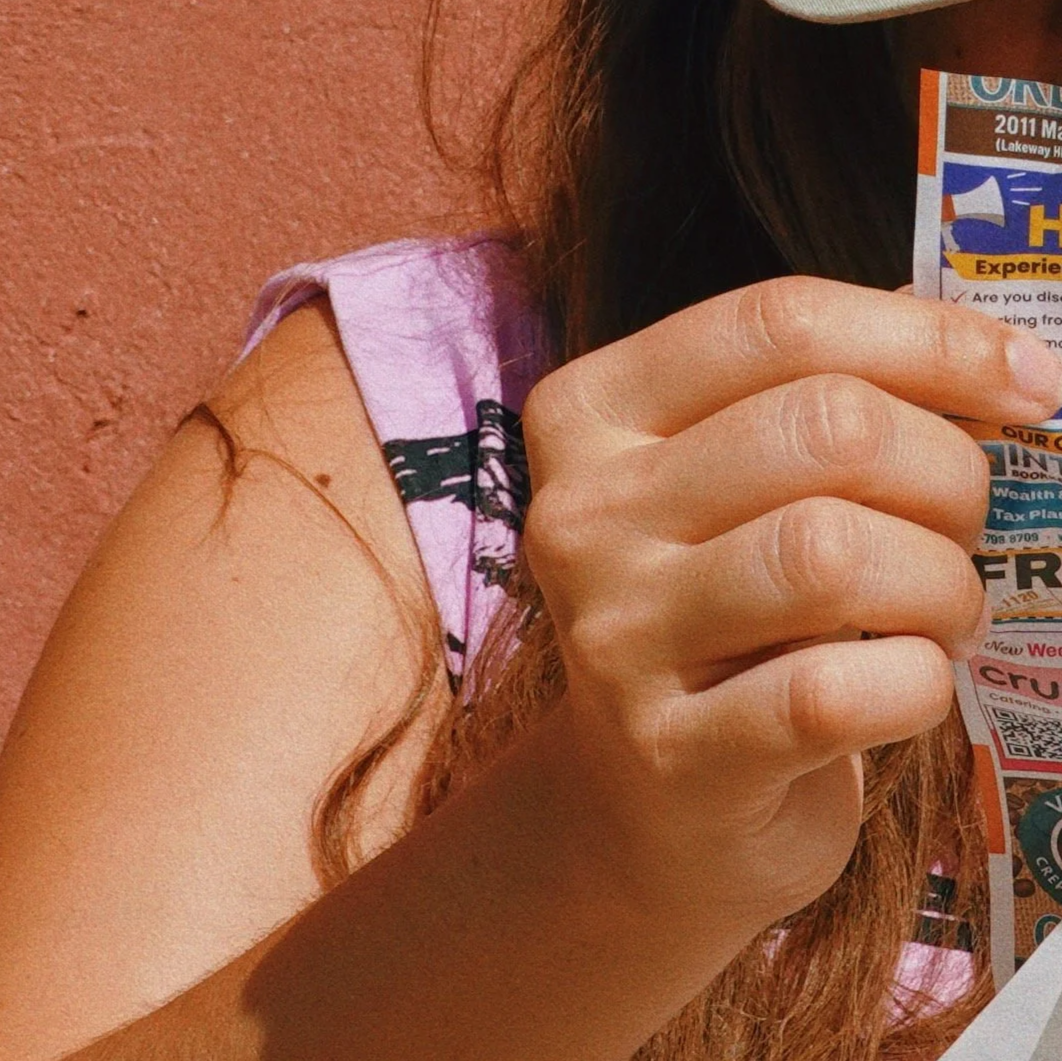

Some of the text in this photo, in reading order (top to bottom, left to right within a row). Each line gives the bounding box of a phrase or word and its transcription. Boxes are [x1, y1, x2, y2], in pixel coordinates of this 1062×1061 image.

[994, 114, 1036, 137] 2011
[995, 138, 1051, 158] (Lakeway
[972, 292, 998, 303] Are
[1002, 293, 1032, 306] you
[998, 314, 1038, 329] king
[1001, 426, 1049, 449] OUR
[992, 487, 1055, 501] Wealth
[992, 508, 1026, 522] Tax
[984, 641, 1024, 656] New
[988, 692, 1052, 714] Catering
